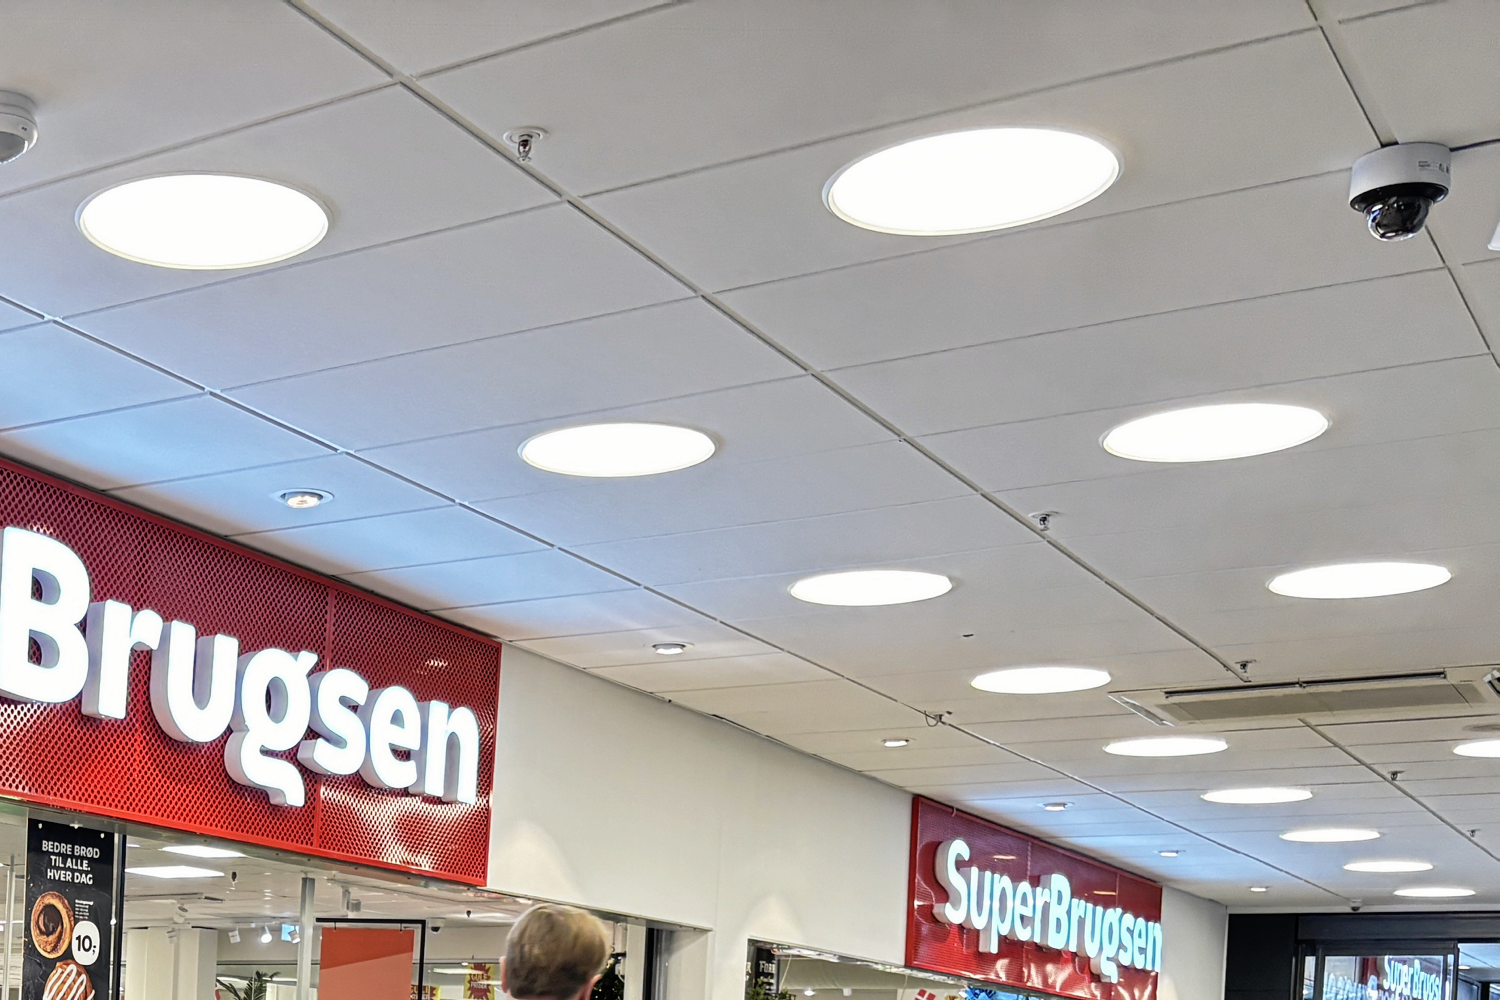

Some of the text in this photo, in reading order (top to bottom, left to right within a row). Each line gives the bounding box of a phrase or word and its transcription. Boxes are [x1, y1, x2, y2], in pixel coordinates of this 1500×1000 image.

[42, 840, 100, 859] BEDRE BRØD
[50, 855, 91, 871] TIL ALLE.
[47, 868, 93, 885] HVER DAG
[933, 838, 1162, 984] SuperBrugsen
